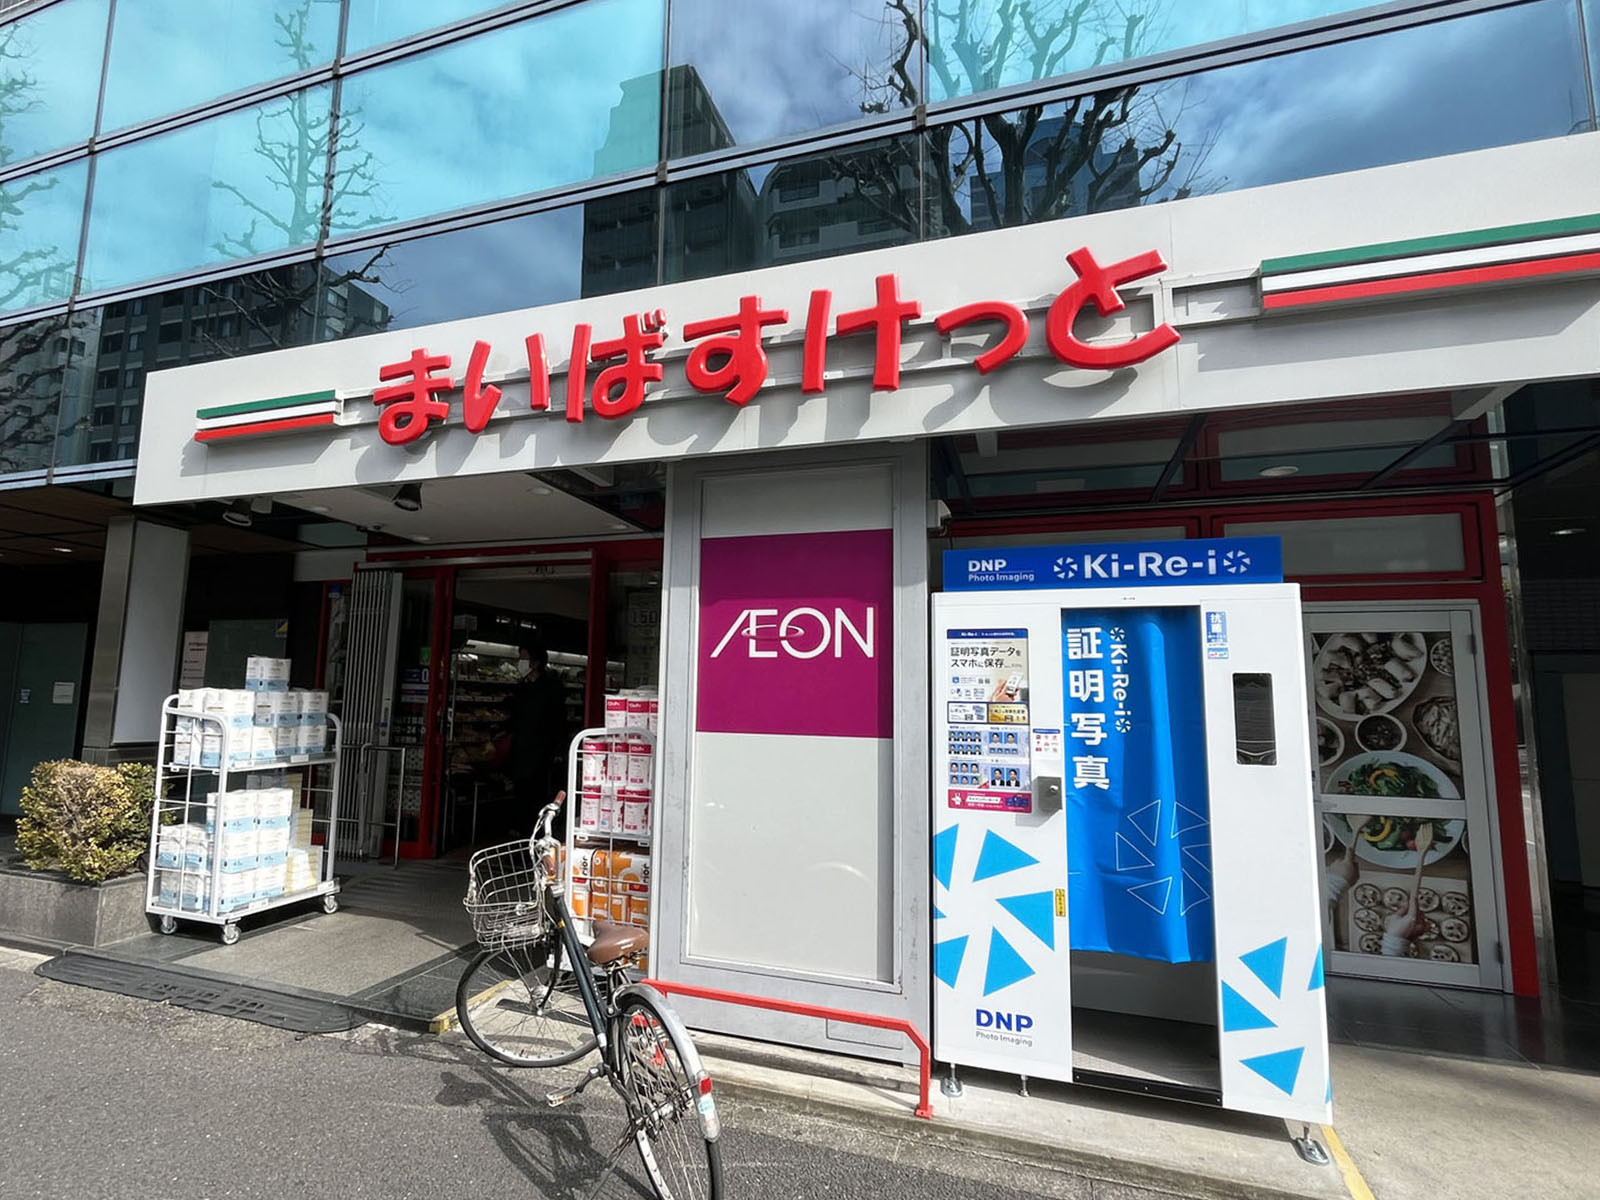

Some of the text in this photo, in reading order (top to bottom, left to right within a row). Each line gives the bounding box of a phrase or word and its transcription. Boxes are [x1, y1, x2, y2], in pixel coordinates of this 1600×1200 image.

[372, 246, 1181, 445] まいばすけっと
[968, 559, 1007, 572] DNP
[968, 571, 1035, 582] Photo Imaging
[1084, 550, 1216, 579] Ki-Re-i
[950, 646, 1021, 657] 証明写真データを
[1109, 644, 1131, 716] Ki-Re-i
[1066, 627, 1110, 790] 証明写真
[976, 1008, 1033, 1032] DNP
[976, 1031, 1033, 1048] Photo Imaging
